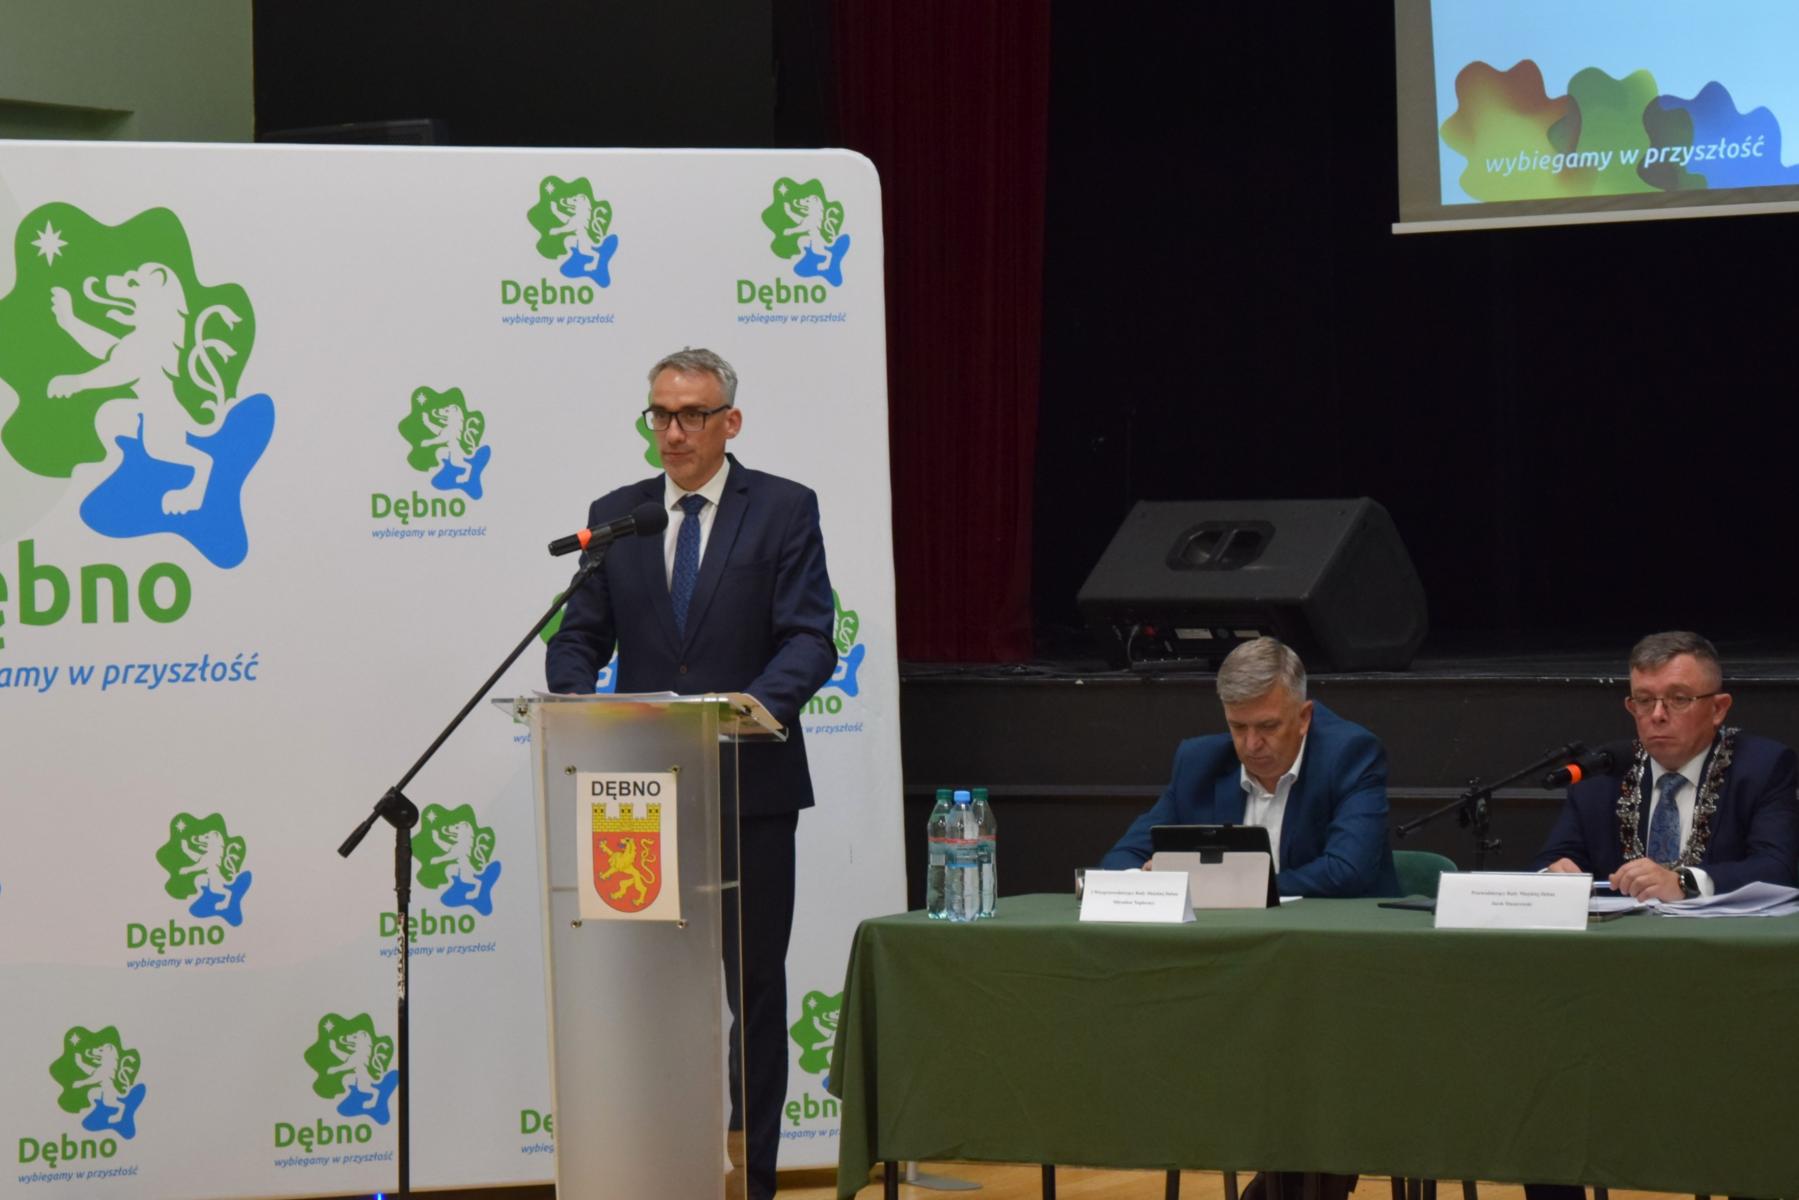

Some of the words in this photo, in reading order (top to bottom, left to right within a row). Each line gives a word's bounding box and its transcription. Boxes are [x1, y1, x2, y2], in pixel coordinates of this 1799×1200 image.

[1485, 149, 1613, 177] wybiegamy
[1620, 149, 1639, 165] w
[1644, 134, 1765, 169] przyszłość
[501, 278, 594, 311] Dębno
[736, 277, 827, 310] Dębno
[502, 313, 554, 325] wybiegamy
[737, 312, 789, 324] wybiegamy
[371, 490, 466, 525] Dębno
[371, 527, 425, 539] wybiegamy
[0, 538, 192, 650] bno
[69, 665, 95, 685] w
[101, 652, 259, 691] przyszłość
[591, 780, 661, 800] DĘBNO
[126, 919, 225, 954] Dębno
[127, 958, 181, 969] wybiegamy
[18, 1132, 117, 1168] Dębno
[274, 1118, 372, 1153] Dębno
[18, 1172, 73, 1184] wybiegamy
[274, 1156, 329, 1168] wybiegamy
